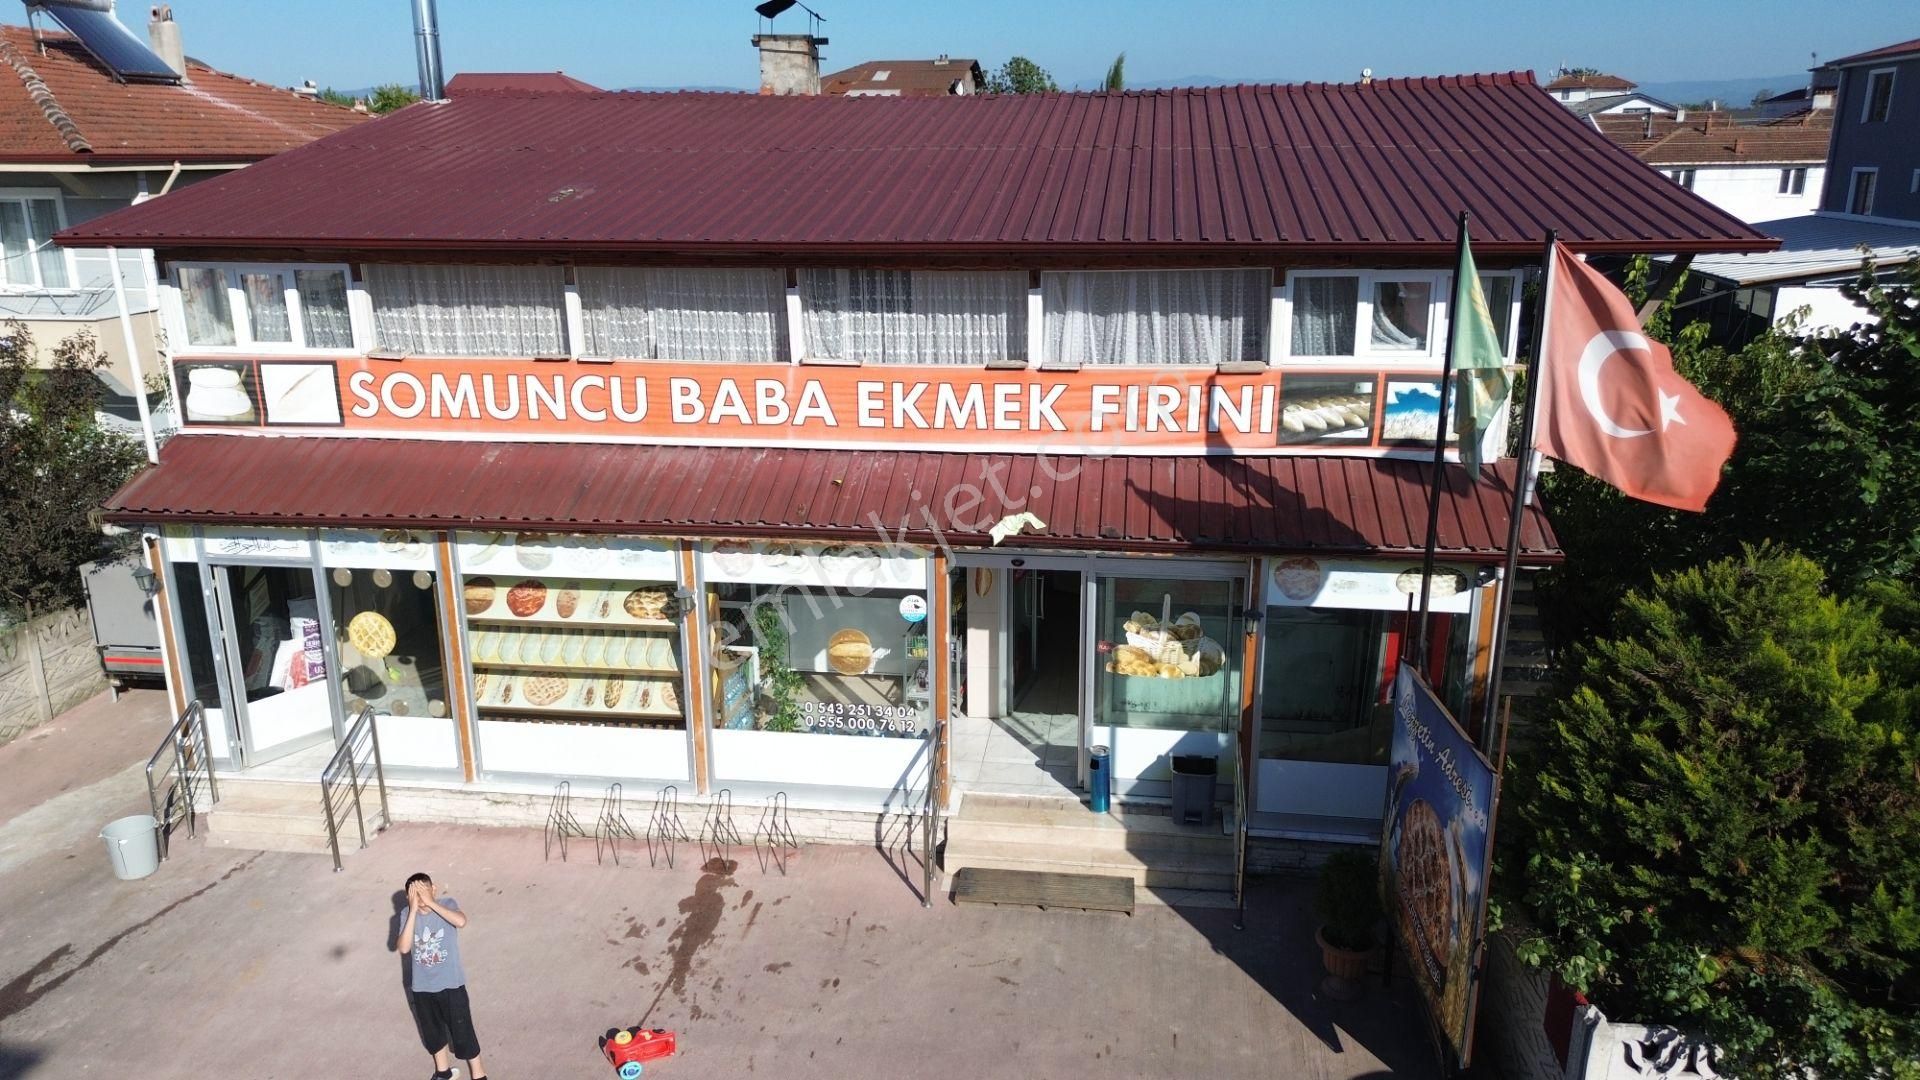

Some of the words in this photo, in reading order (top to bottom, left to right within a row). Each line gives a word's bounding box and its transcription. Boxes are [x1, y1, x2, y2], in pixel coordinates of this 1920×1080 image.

[348, 371, 648, 424] SOMUNCU
[669, 378, 839, 427] BABA
[857, 380, 1067, 432] EKMEK
[1090, 385, 1275, 433] FIRINI
[804, 702, 813, 714] 0
[818, 702, 844, 715] 543
[848, 704, 871, 716] 251
[875, 705, 893, 717] 34
[897, 707, 915, 718] 04
[805, 715, 814, 727] 0
[818, 716, 844, 728] 555
[848, 718, 875, 730] 000
[879, 719, 896, 731] 76
[900, 721, 916, 733] 12
[1398, 692, 1436, 754] Lezzetin
